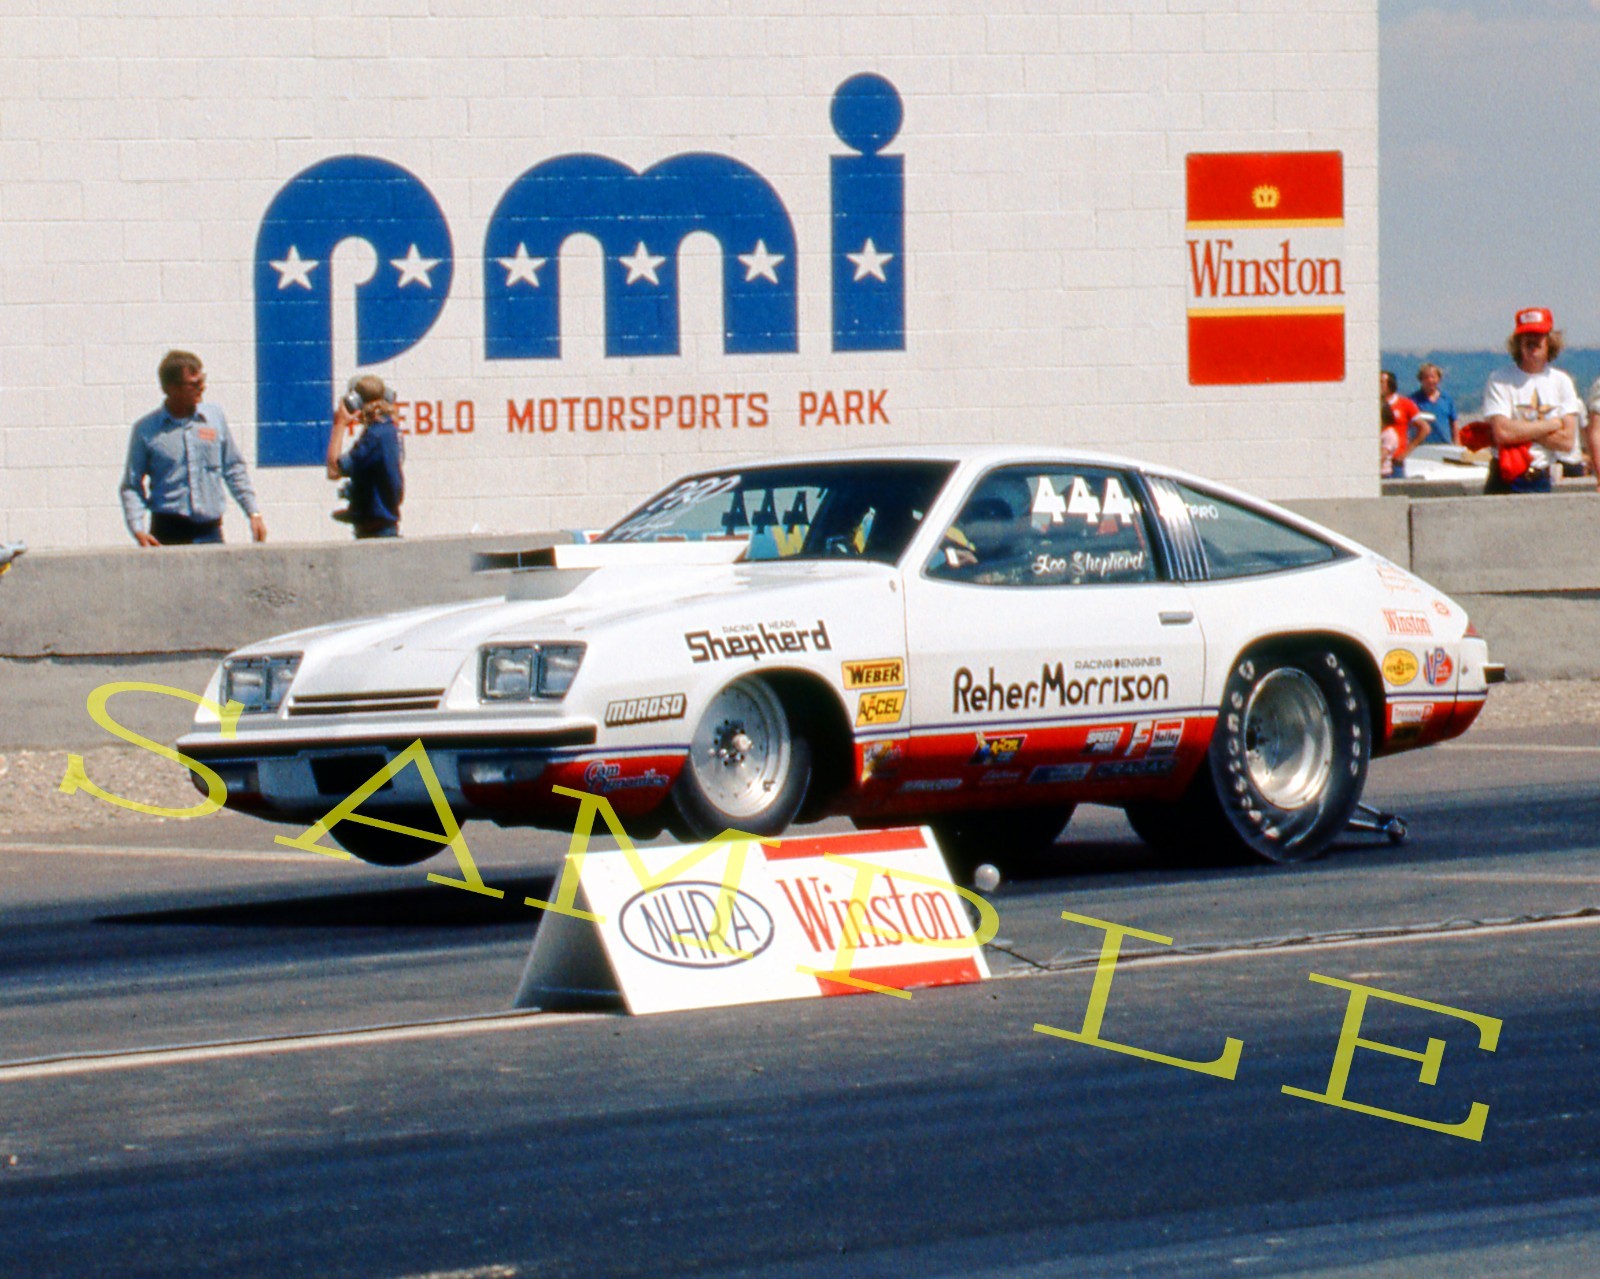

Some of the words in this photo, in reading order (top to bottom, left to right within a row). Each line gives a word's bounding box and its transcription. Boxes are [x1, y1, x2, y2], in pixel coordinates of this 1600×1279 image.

[1187, 240, 1345, 298] Winston
[507, 391, 770, 434] MOTORSPORTS
[800, 388, 892, 427] PARK
[1032, 475, 1136, 526] 444
[684, 619, 833, 664] Shepherd
[768, 619, 797, 630] HEADS
[1382, 609, 1432, 634] Winston
[845, 663, 901, 685] WEBER
[1075, 659, 1113, 670] RACING
[1119, 656, 1163, 669] ENGINES
[640, 887, 761, 960] NHRA
[776, 868, 966, 955] Winston
